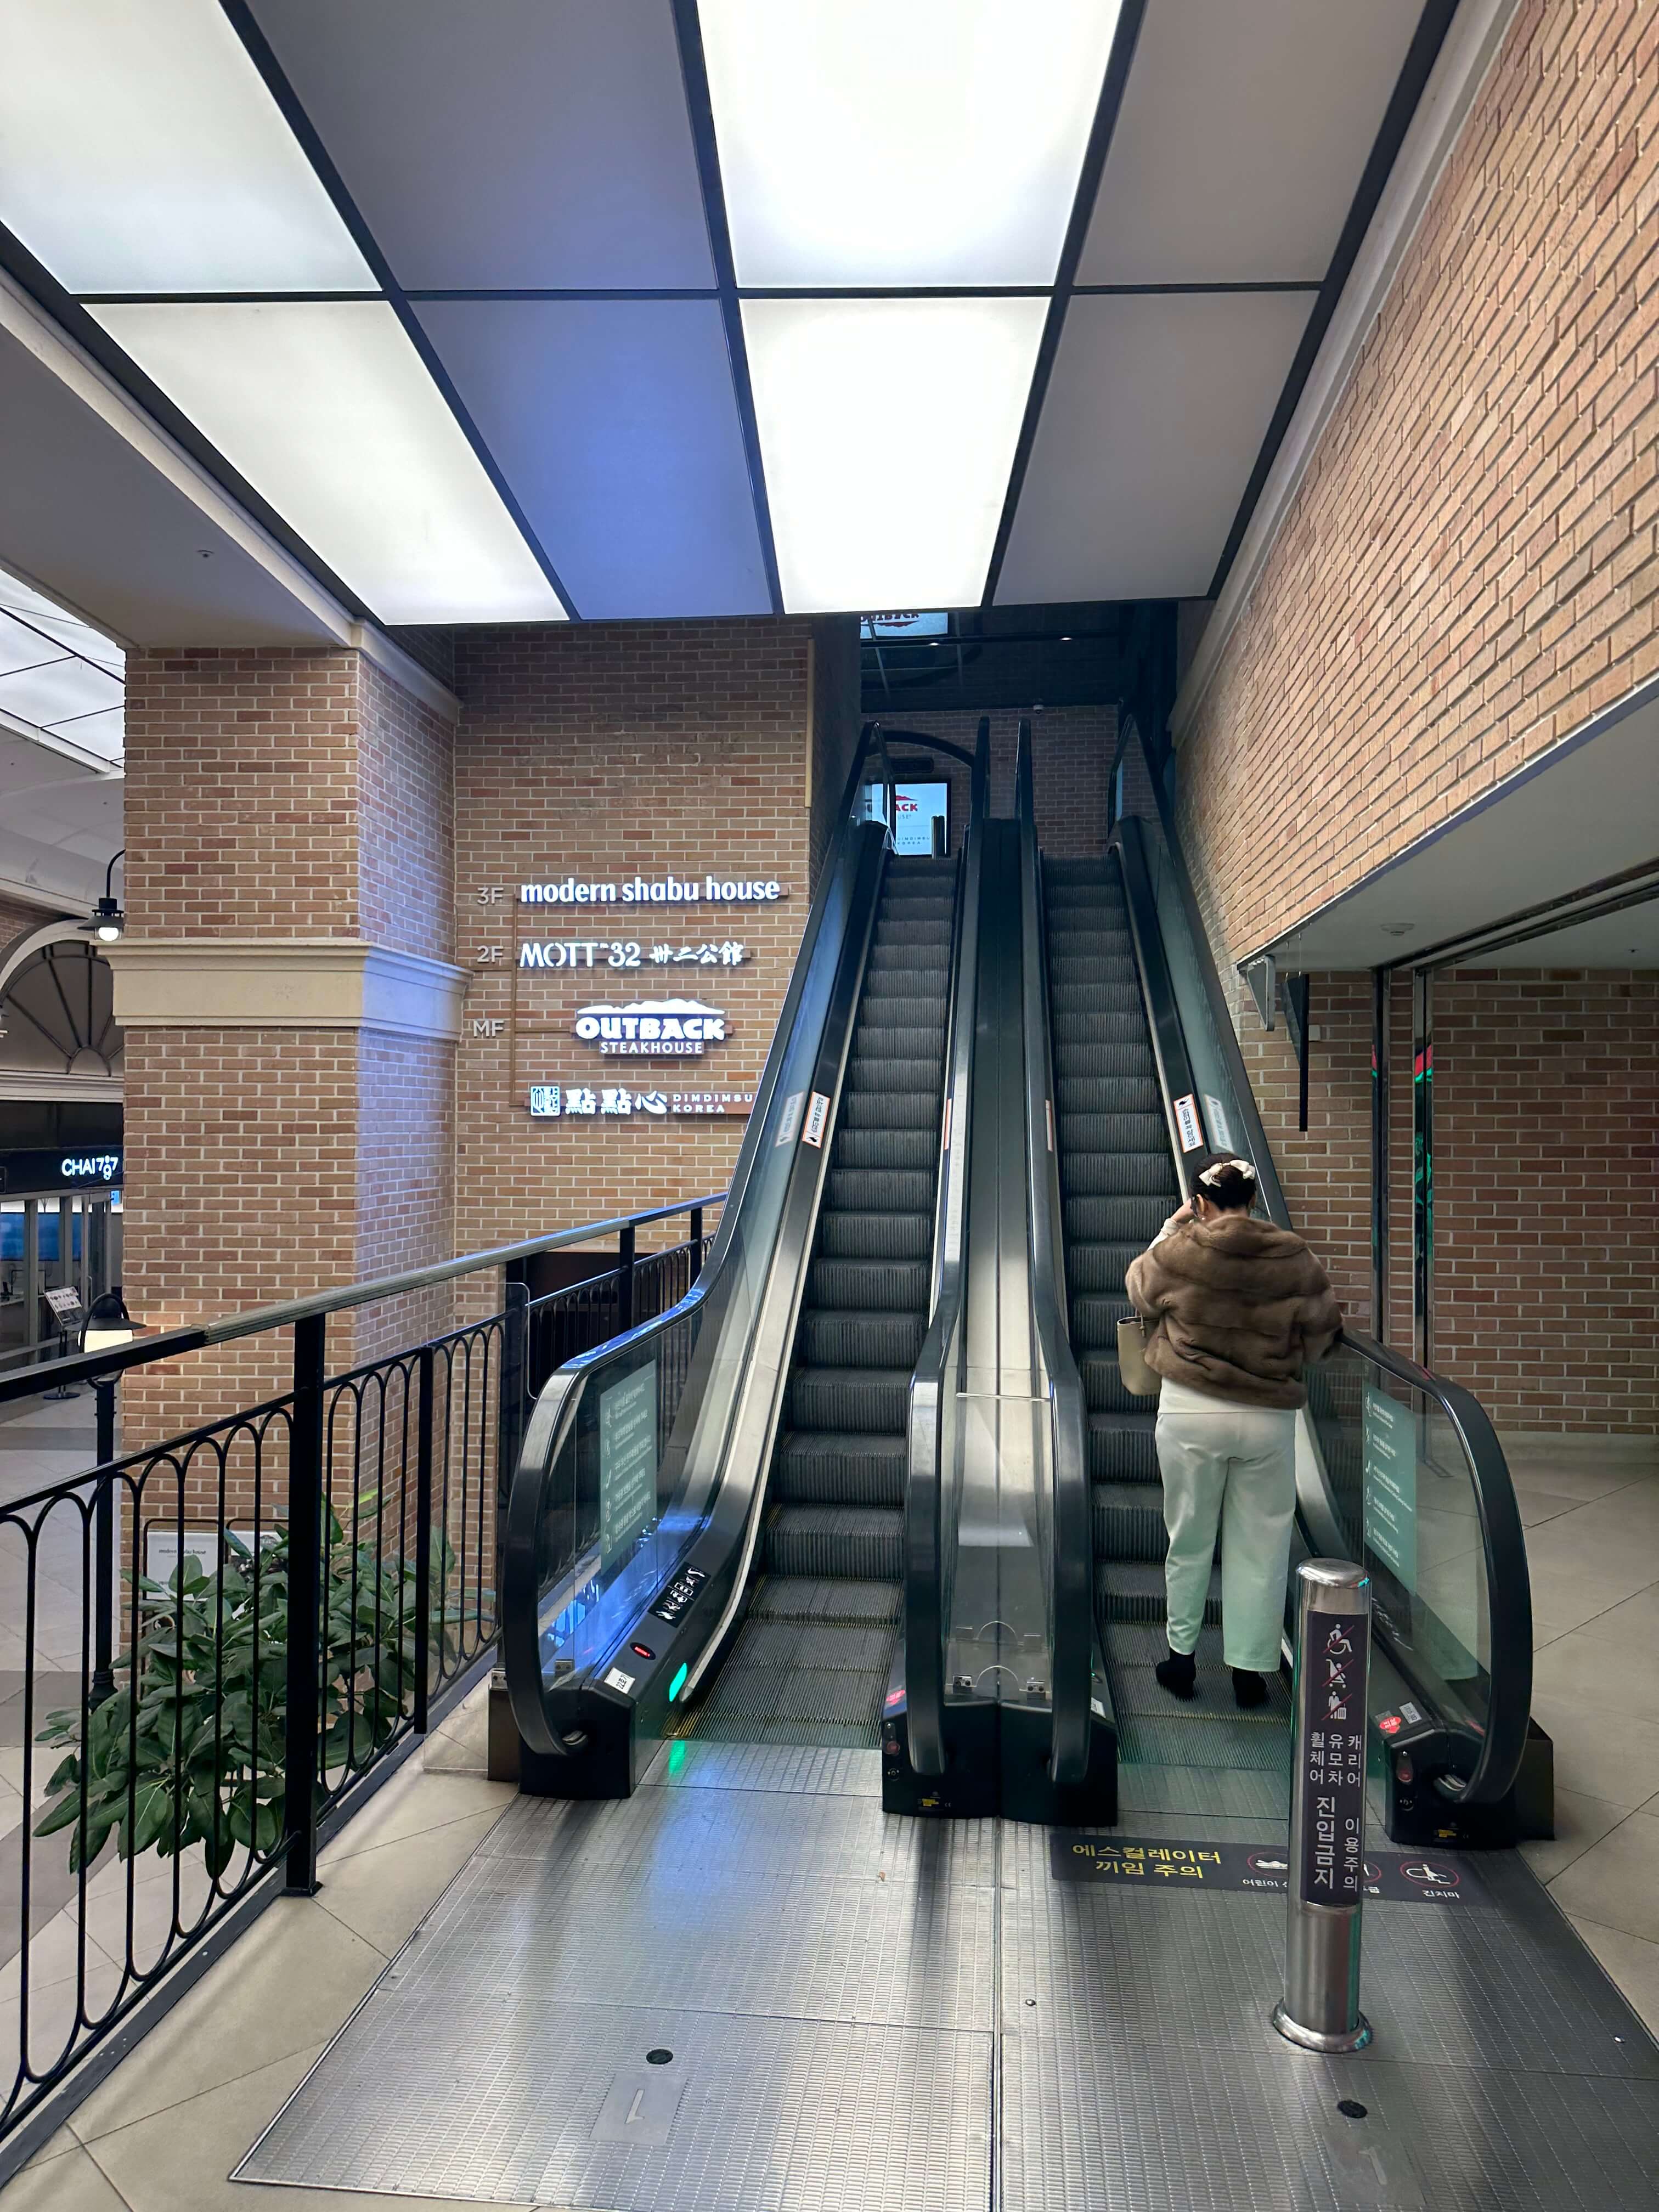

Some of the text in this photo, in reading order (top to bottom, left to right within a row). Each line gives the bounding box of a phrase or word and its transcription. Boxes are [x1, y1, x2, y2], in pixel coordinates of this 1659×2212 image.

[477, 887, 504, 904] 3F
[520, 876, 780, 902] modern shabu house
[477, 945, 504, 963] 2F
[473, 1019, 505, 1038] MF
[575, 1017, 725, 1040] OUTBACK
[600, 1042, 703, 1054] STEAKHOUSE
[673, 1094, 753, 1102] DIMDIMSU
[673, 1104, 725, 1113] KOREA
[1310, 1731, 1325, 1785] 휠체어
[1327, 1733, 1344, 1786] 유모차
[1347, 1735, 1362, 1787] 캐리어
[1313, 1796, 1335, 1889] 진입금지
[1072, 1844, 1222, 1864] 에스컬레이터
[1342, 1818, 1359, 1892] 이용주의
[1095, 1861, 1203, 1879] 끼임 주의
[1242, 1878, 1279, 1888] 어린이
[1422, 1889, 1460, 1899] 긴치마
